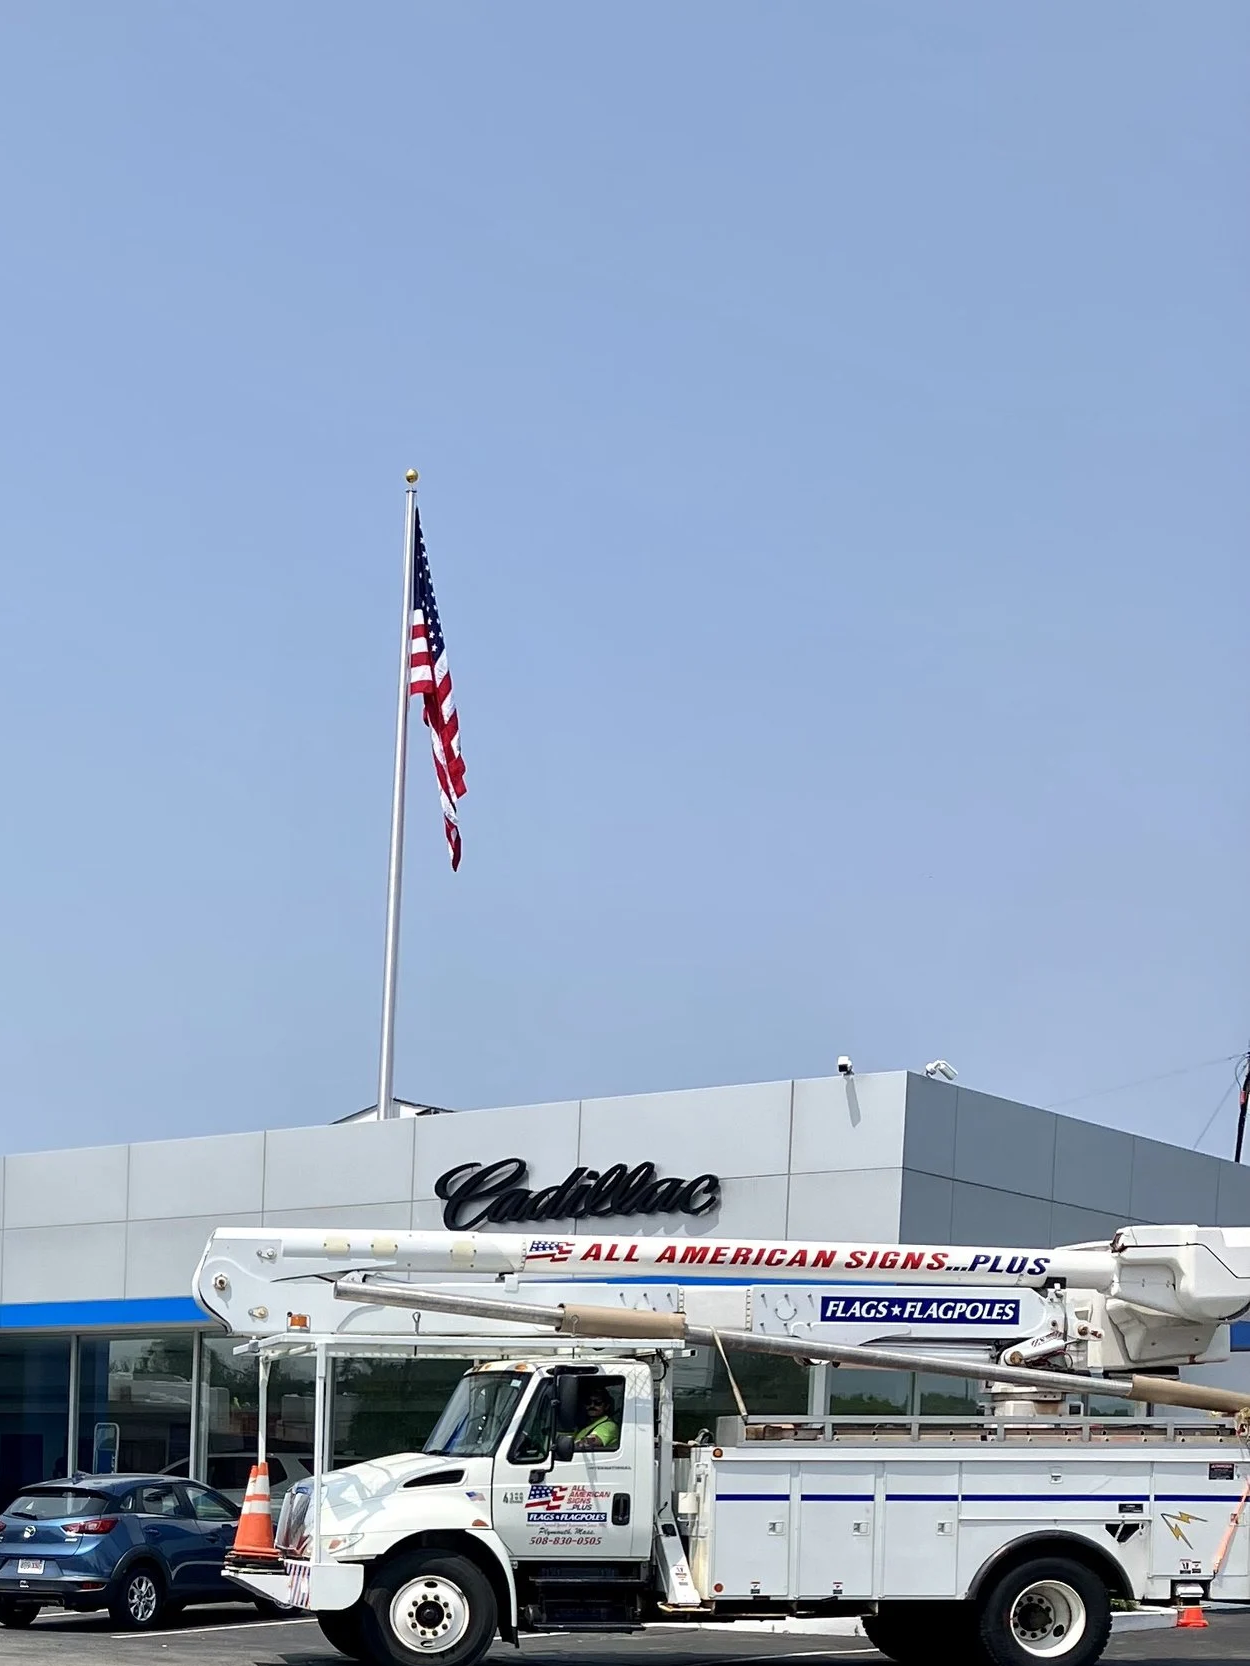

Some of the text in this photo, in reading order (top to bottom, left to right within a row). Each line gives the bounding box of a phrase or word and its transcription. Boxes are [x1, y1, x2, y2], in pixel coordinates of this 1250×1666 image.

[434, 1157, 719, 1231] Cadillac
[580, 1243, 640, 1263] ALL
[654, 1245, 837, 1269] AMERICAN
[825, 1300, 1016, 1321] FLAGS FLAGPOLES
[529, 1513, 606, 1521] FLAGS FLAGPOLES
[528, 1536, 603, 1546] 508-830-0505
